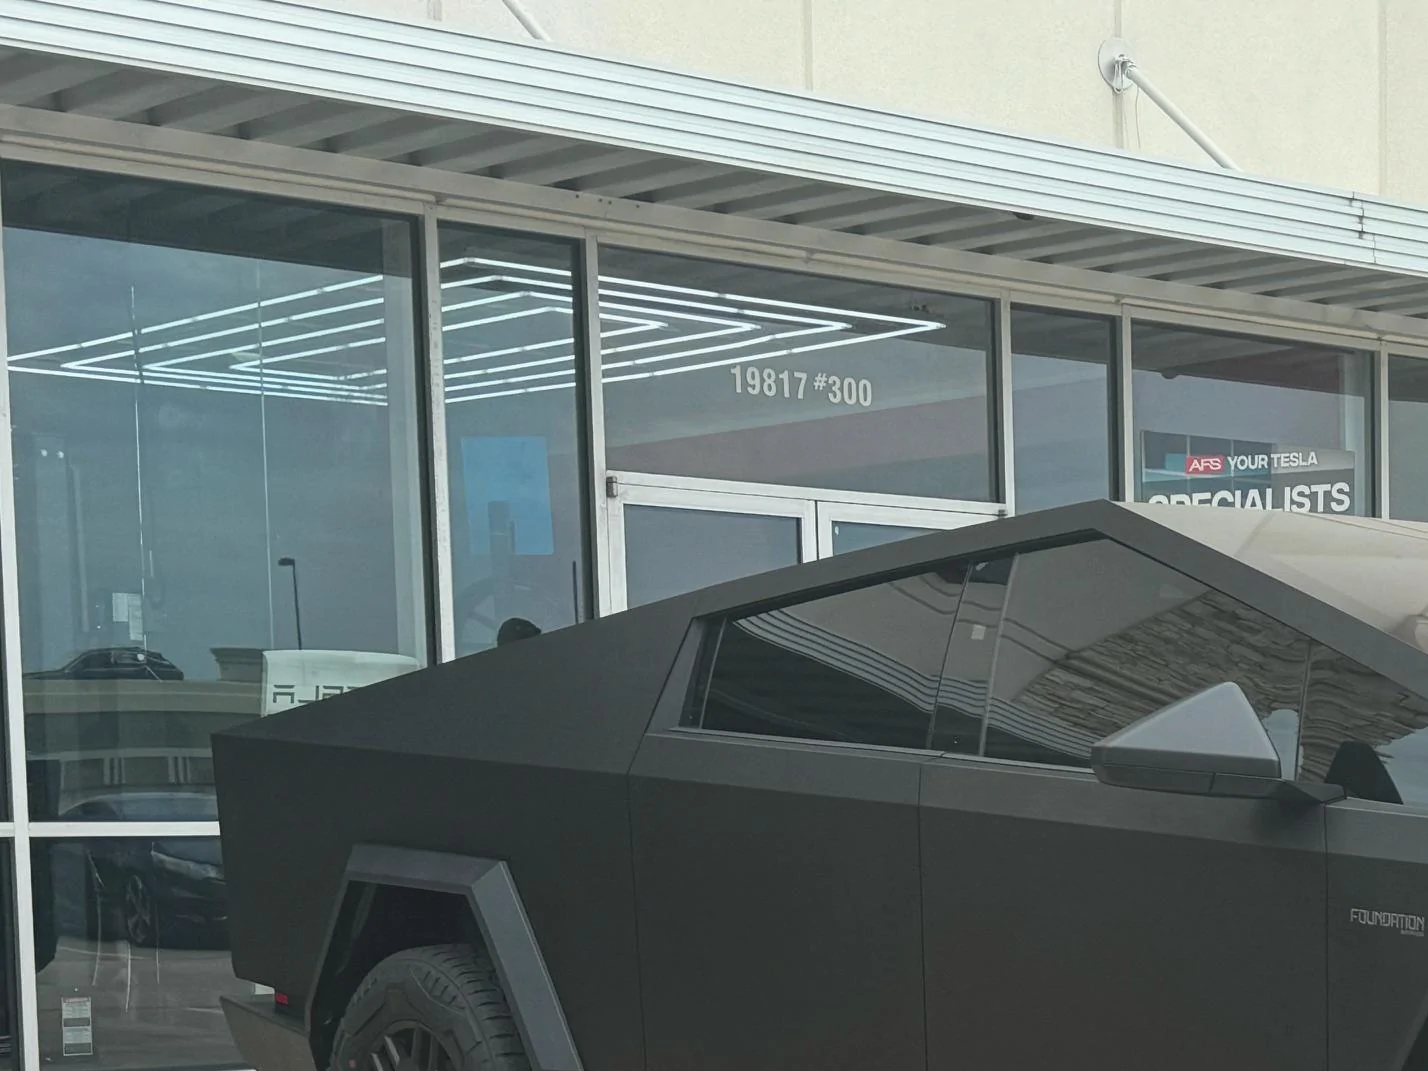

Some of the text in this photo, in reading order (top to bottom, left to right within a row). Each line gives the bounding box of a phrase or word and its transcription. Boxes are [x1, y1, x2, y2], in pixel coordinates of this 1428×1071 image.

[730, 364, 872, 407] 19817 #300
[1188, 451, 1319, 473] AFS YOUR TESLA
[1350, 908, 1425, 931] FOUNDATION
